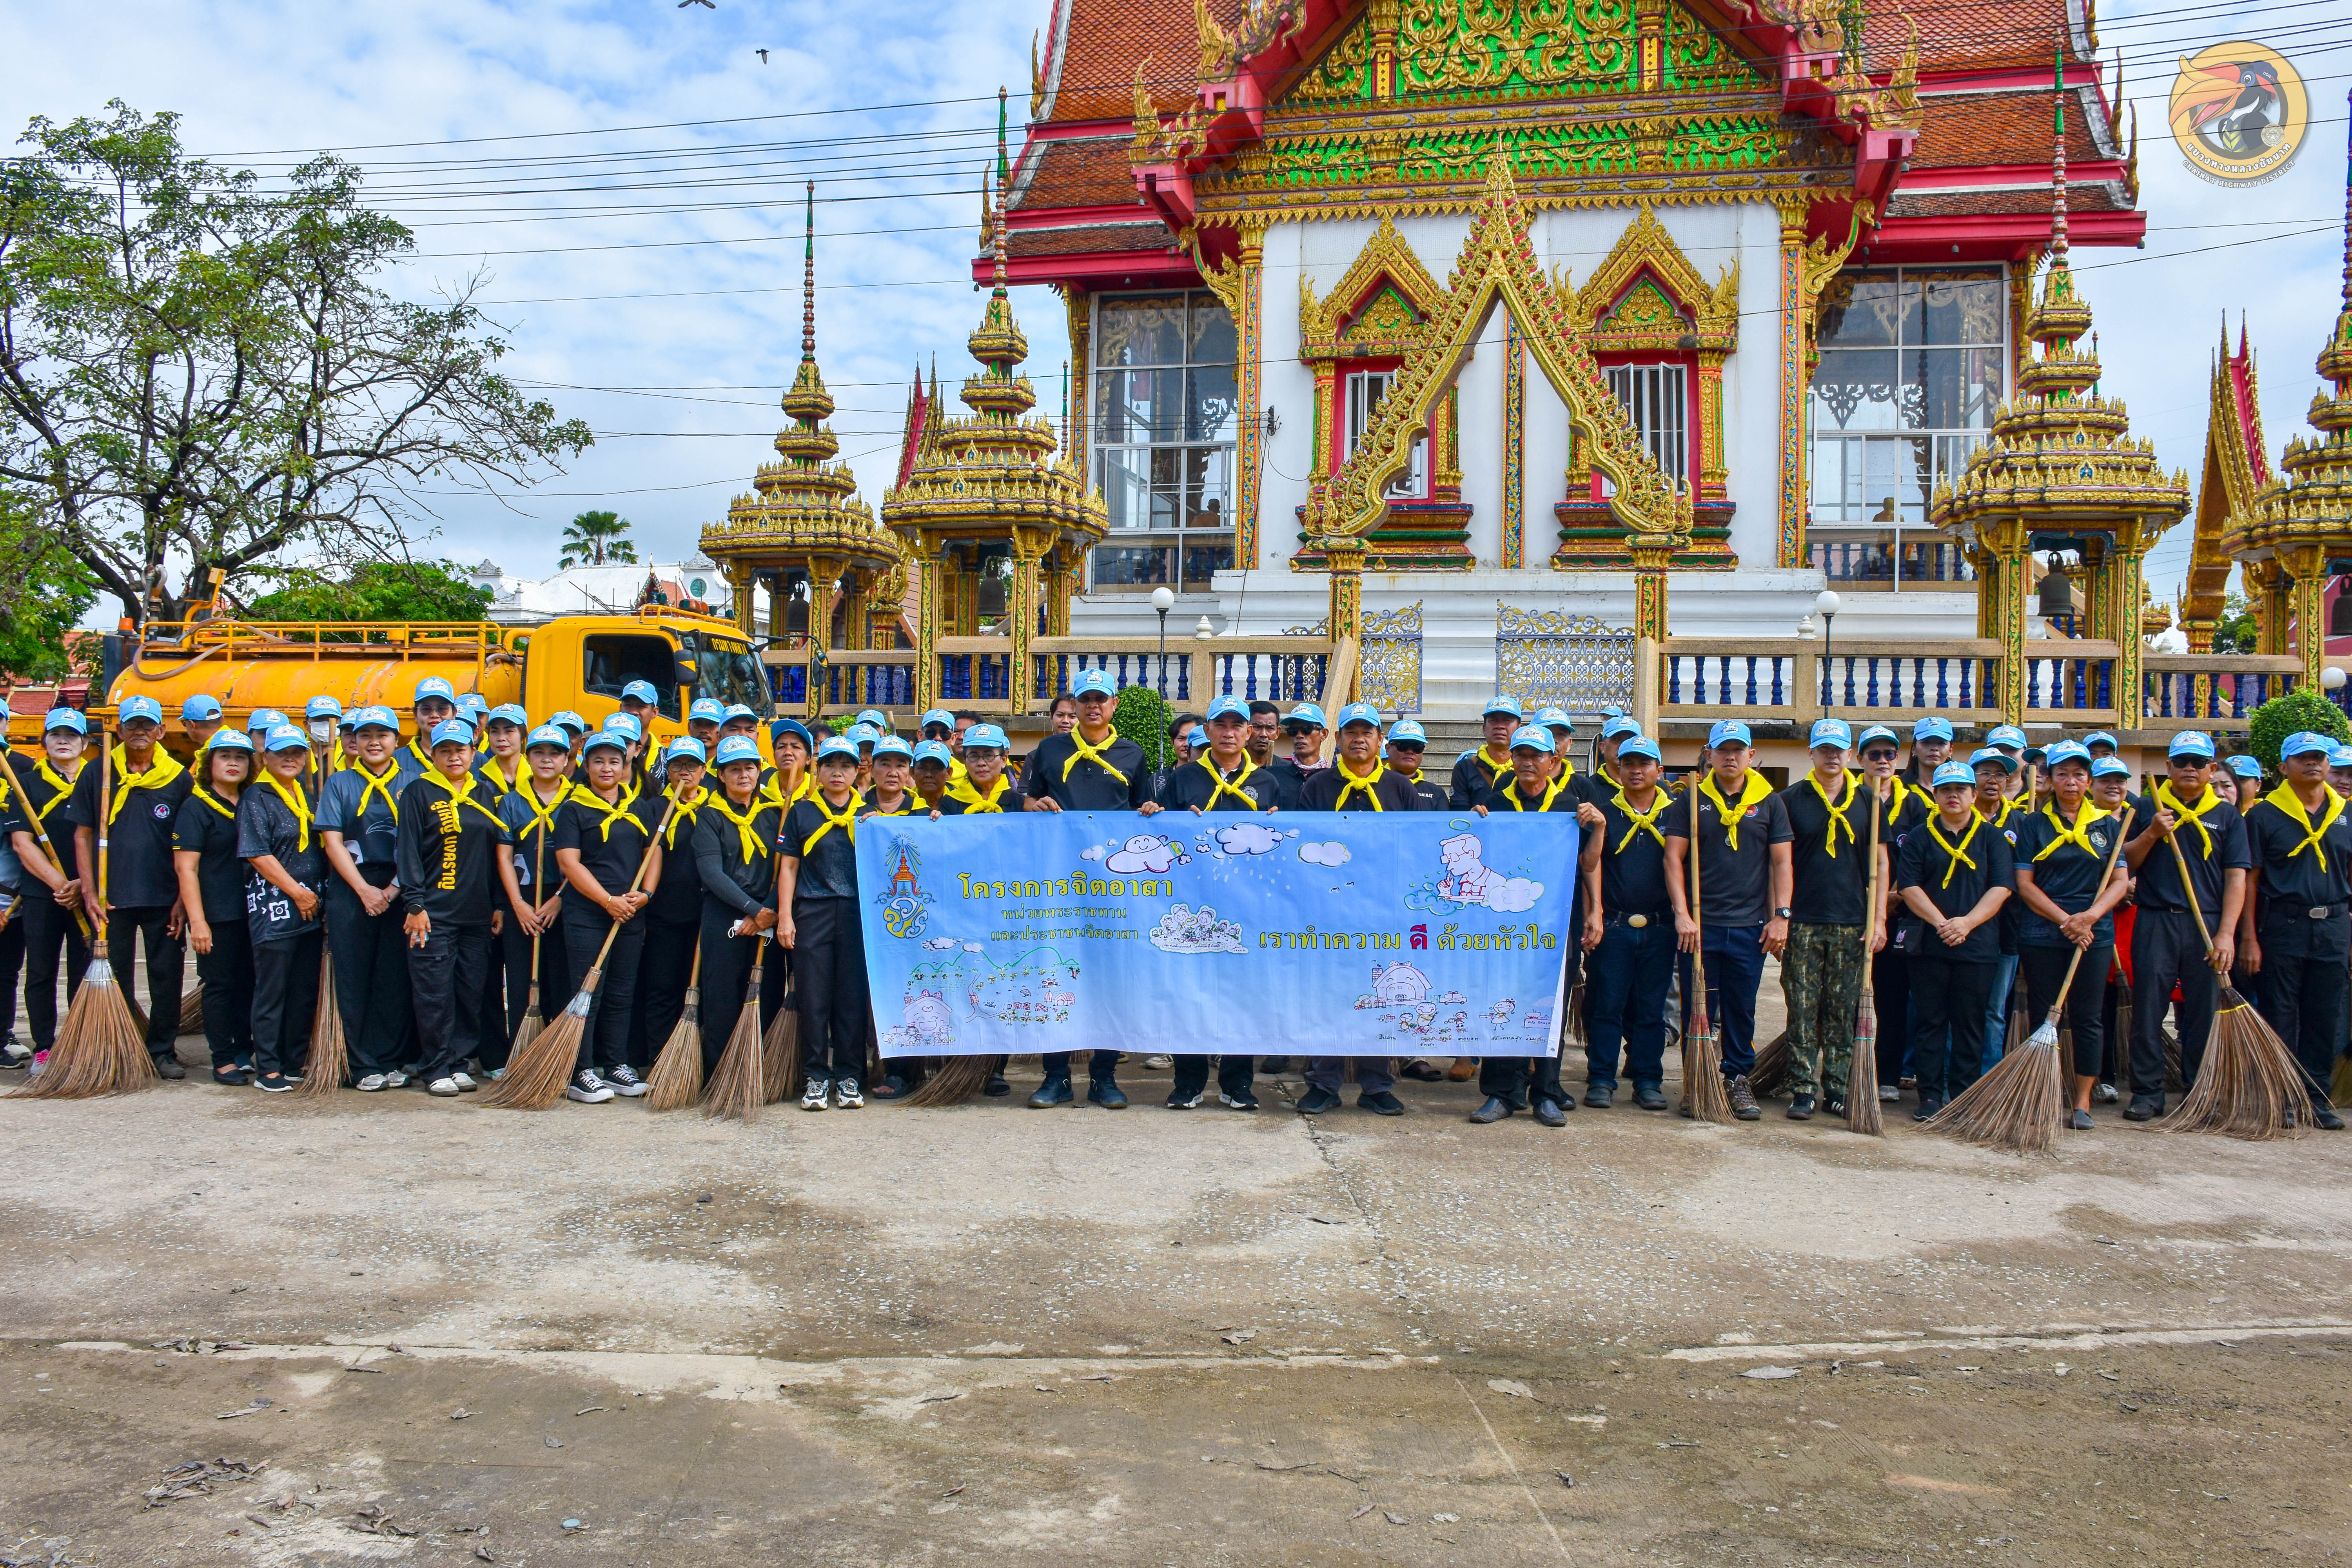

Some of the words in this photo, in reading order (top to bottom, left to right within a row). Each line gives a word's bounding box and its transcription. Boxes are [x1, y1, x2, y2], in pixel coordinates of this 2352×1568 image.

[956, 871, 1173, 899] โครงการจิตอาสา
[1001, 903, 1127, 920] หน่วยพระราชทาน
[991, 924, 1139, 942] และประชาชนจิตอาสา
[1259, 926, 1401, 950] เราทำความ
[1409, 923, 1428, 950] ดี
[1437, 923, 1557, 950] ด้วยหัวใจ
